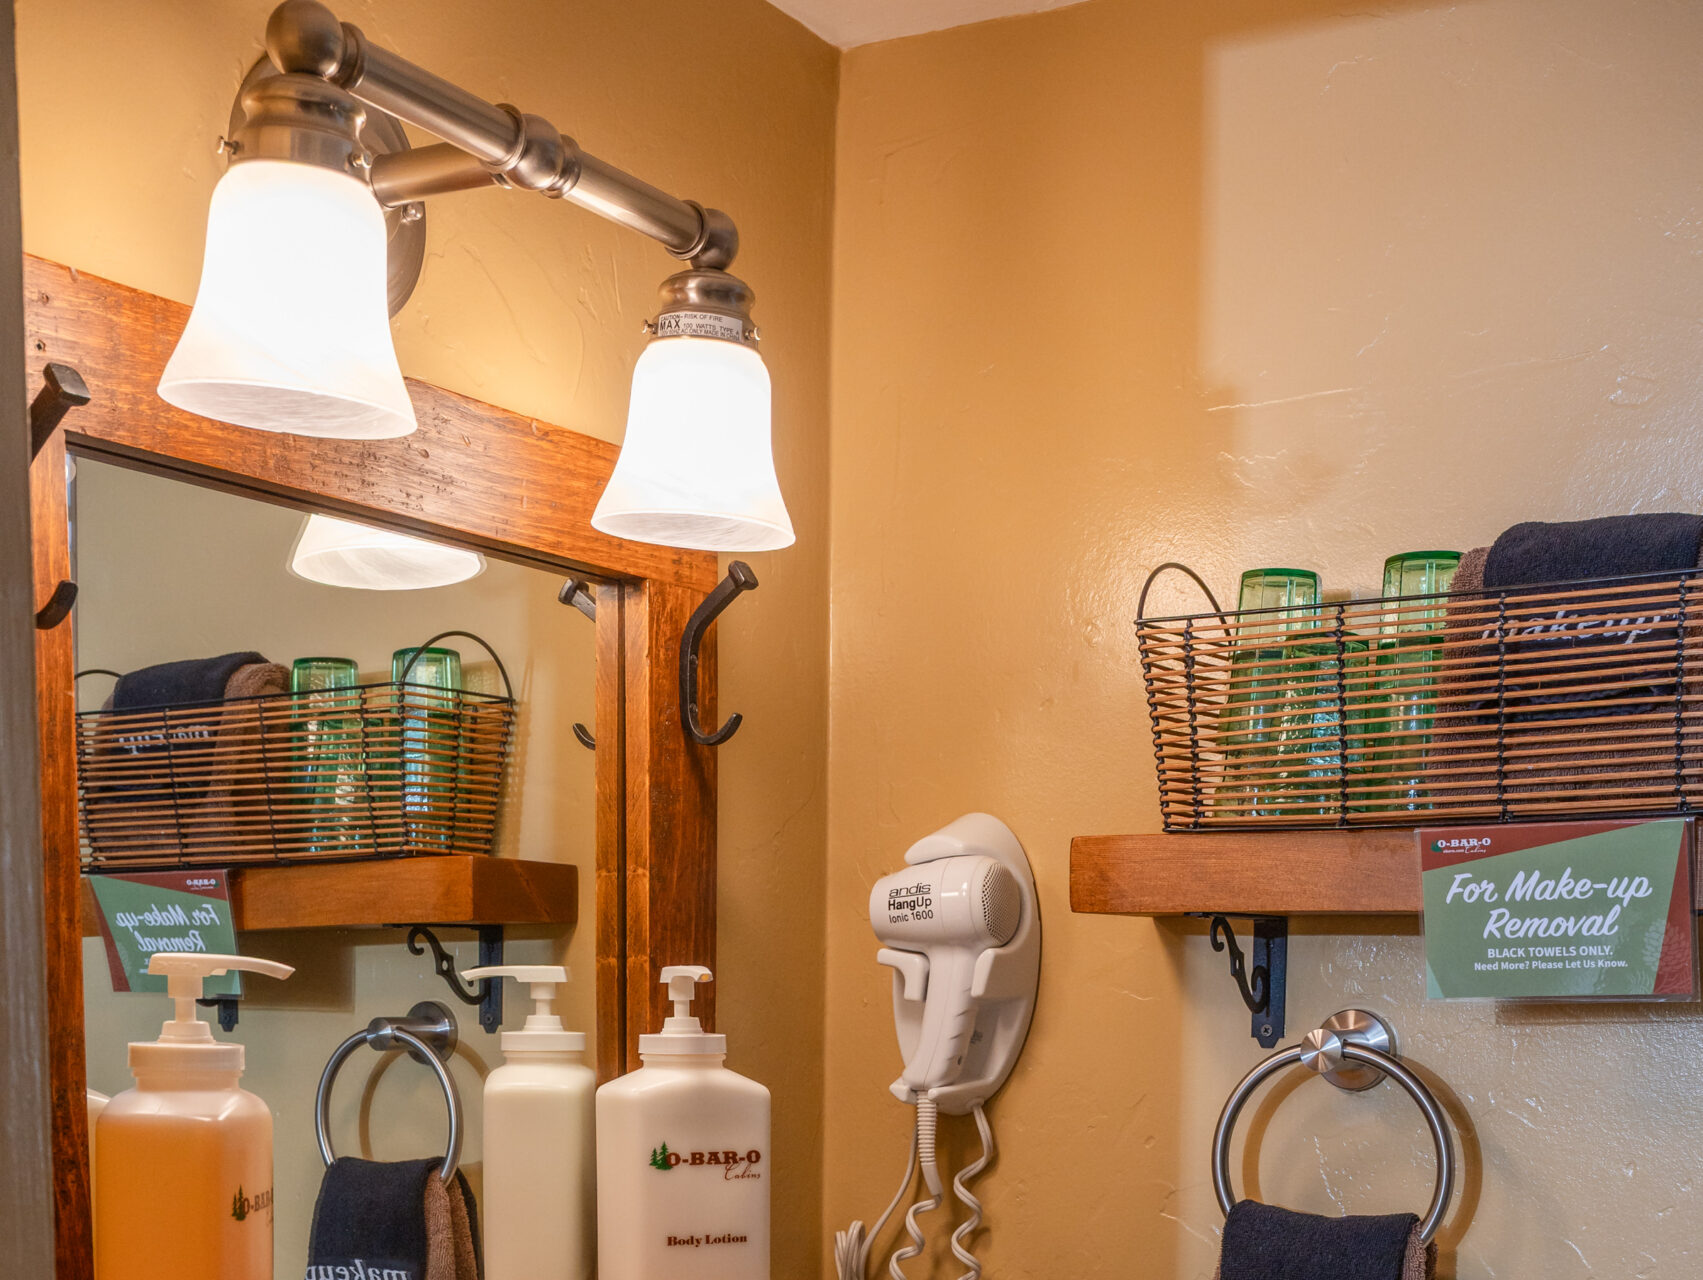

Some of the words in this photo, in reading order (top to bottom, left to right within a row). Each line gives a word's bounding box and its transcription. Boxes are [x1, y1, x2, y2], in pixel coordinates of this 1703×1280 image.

[660, 319, 680, 330] MAX
[1437, 838, 1491, 848] O-BAR-O
[889, 883, 931, 897] andis
[1446, 873, 1498, 904] For
[1505, 867, 1652, 907] Make-up
[888, 896, 932, 911] HangUp
[889, 913, 909, 924] Ionic
[911, 910, 933, 920] 1600
[1483, 904, 1622, 939] Removal
[1487, 948, 1525, 958] BLACK
[1528, 946, 1576, 957] TOWELS
[1579, 945, 1613, 956] ONLY.
[1474, 962, 1498, 970] Need
[1501, 961, 1529, 970] More?
[1532, 961, 1563, 969] Please
[1566, 960, 1580, 968] Let
[1583, 960, 1595, 968] Us
[1598, 959, 1628, 968] Know.
[666, 1150, 761, 1167] O-BAR-O
[724, 1162, 761, 1181] Cabins
[667, 1235, 702, 1247] Body
[705, 1233, 747, 1245] Lotion
